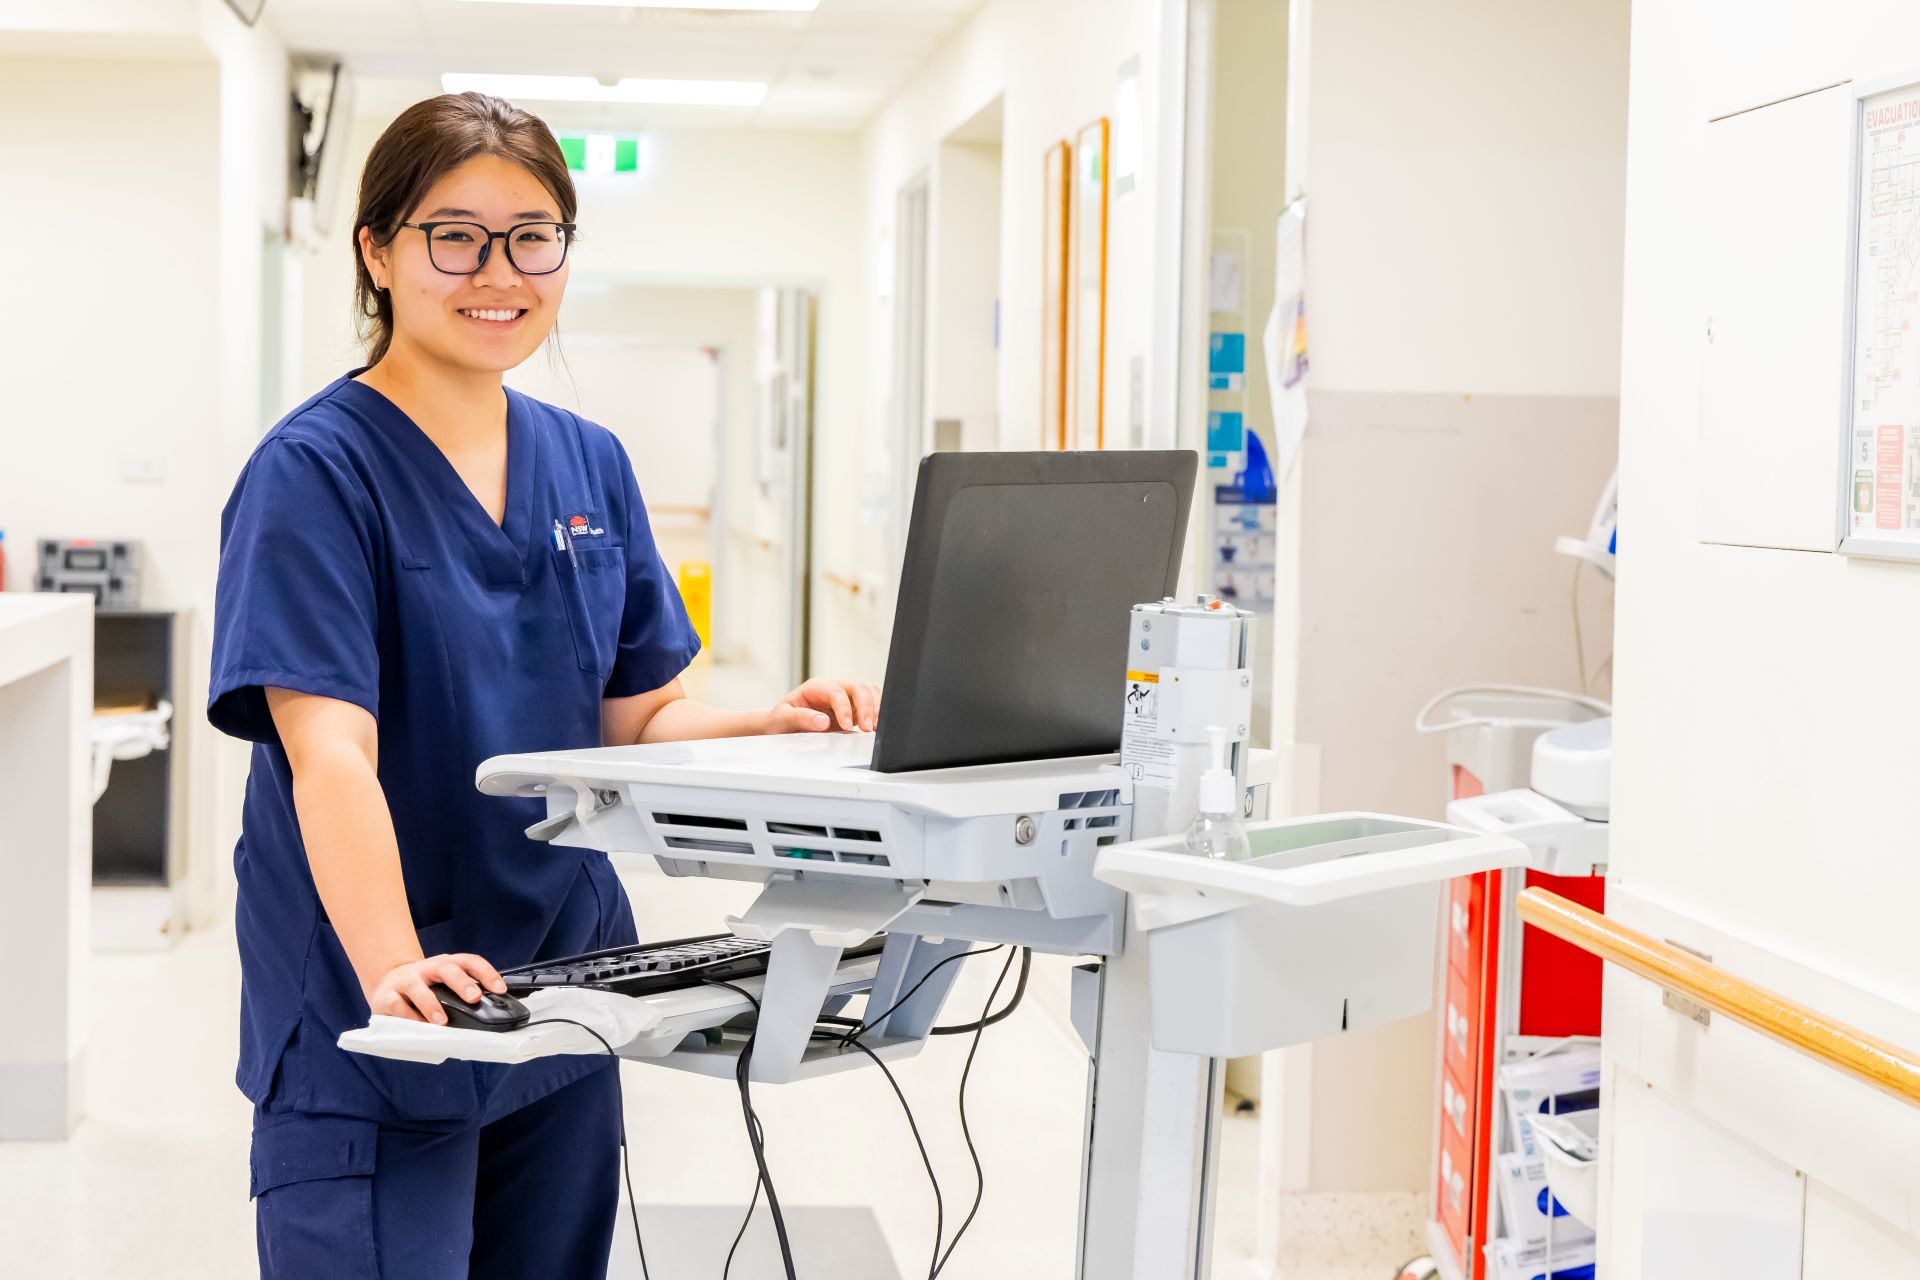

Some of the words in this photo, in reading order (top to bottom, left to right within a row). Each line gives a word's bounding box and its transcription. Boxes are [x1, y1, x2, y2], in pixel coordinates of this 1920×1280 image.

[1866, 100, 1920, 129] EVACUATIO
[1862, 441, 1868, 462] 5
[570, 525, 588, 534] NSW
